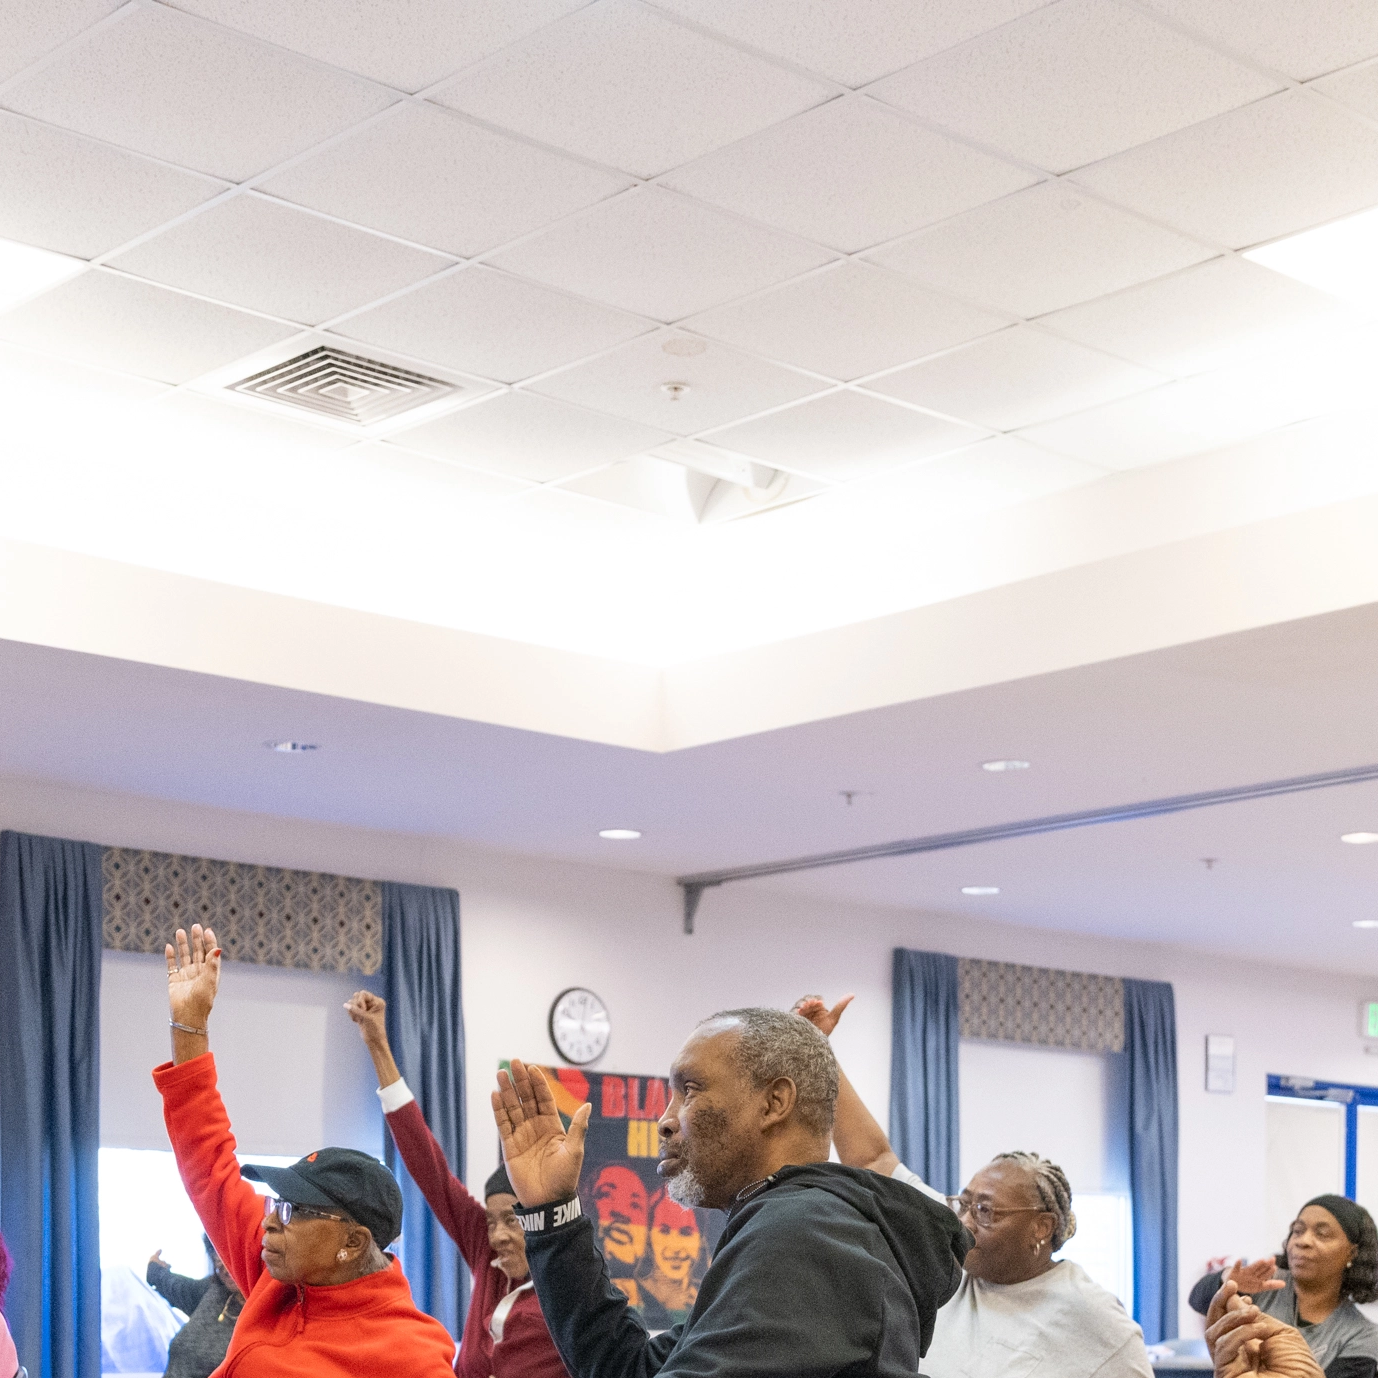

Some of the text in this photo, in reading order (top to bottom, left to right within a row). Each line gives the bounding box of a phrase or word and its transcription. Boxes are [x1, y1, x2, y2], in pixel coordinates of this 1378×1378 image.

[602, 1075, 673, 1119] BLA
[627, 1120, 660, 1158] HI
[553, 1195, 582, 1228] NIKE
